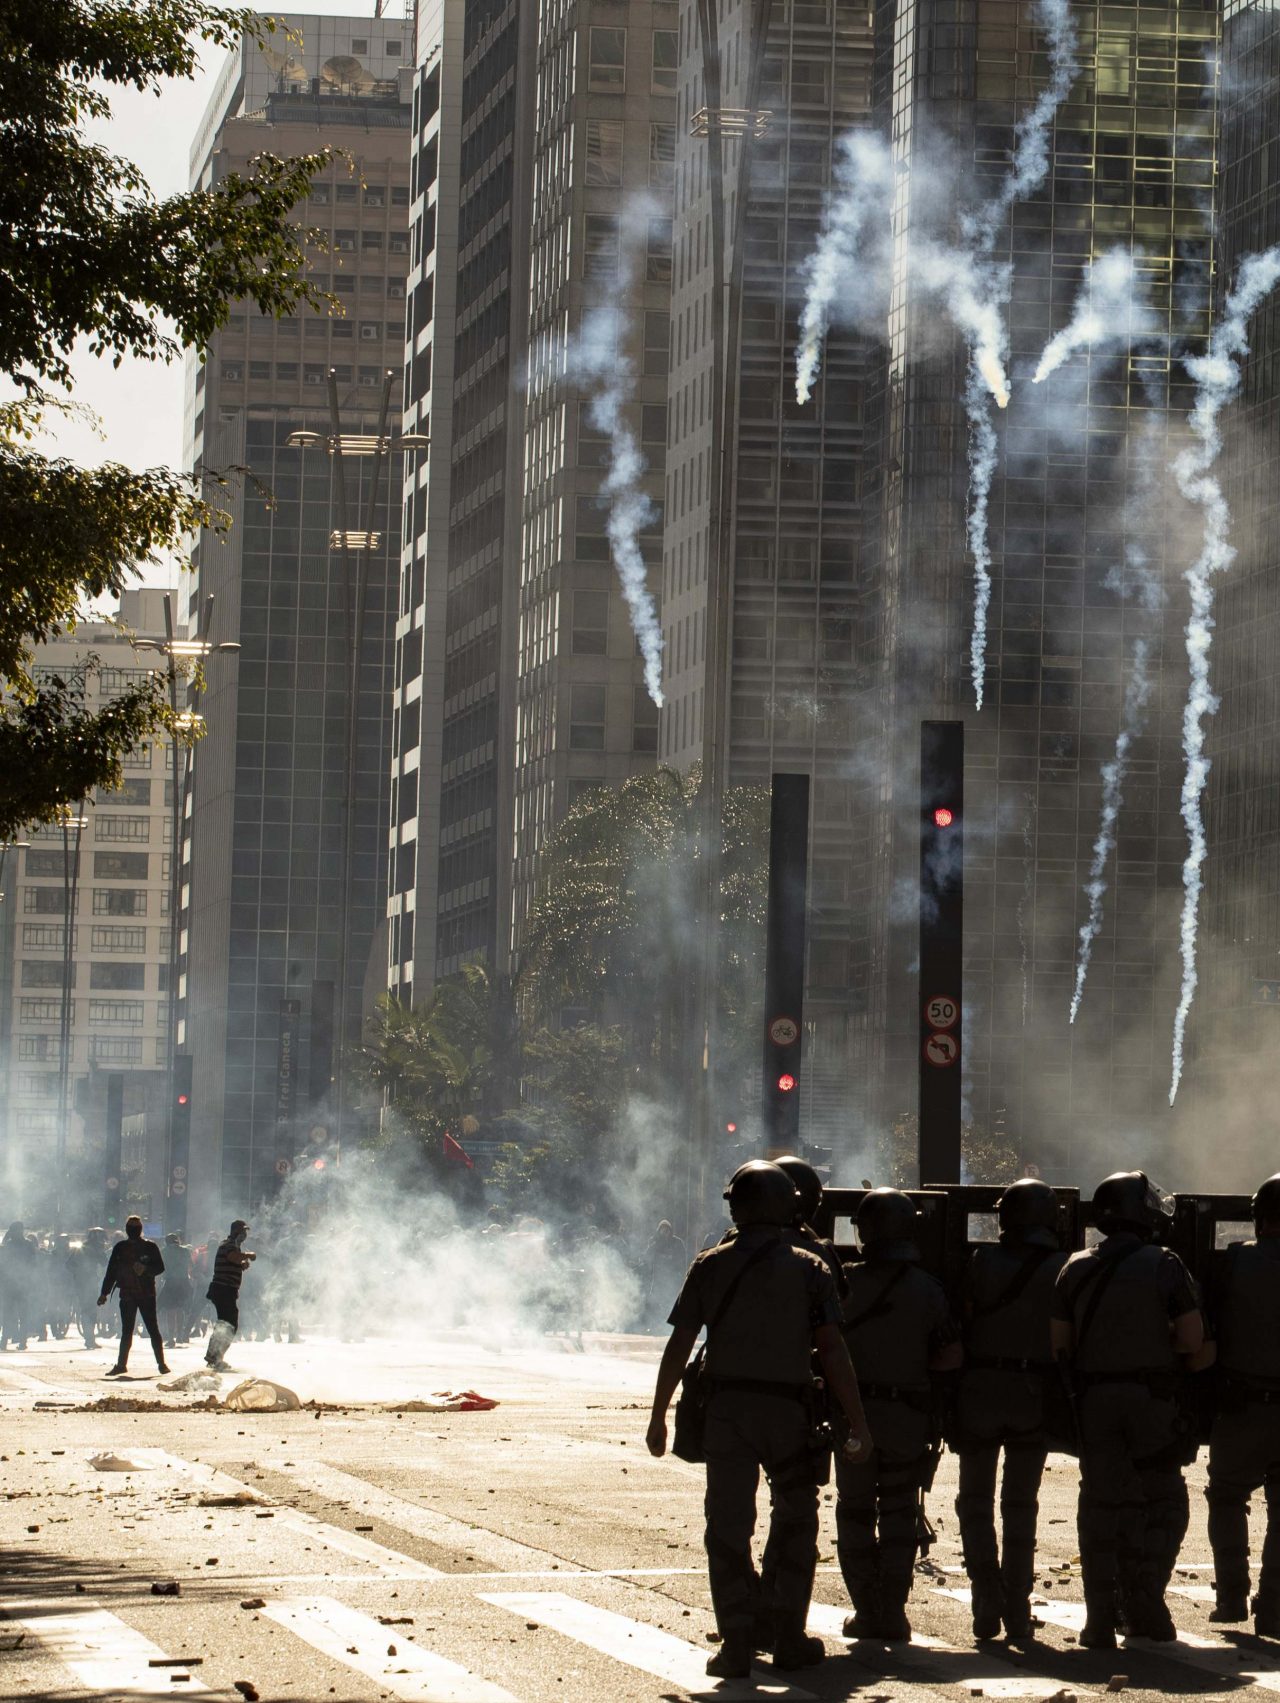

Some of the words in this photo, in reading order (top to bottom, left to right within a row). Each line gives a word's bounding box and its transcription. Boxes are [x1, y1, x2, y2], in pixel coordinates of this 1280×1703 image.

[931, 1003, 953, 1019] 50
[280, 1032, 291, 1078] Caneca
[278, 1083, 289, 1109] Frei
